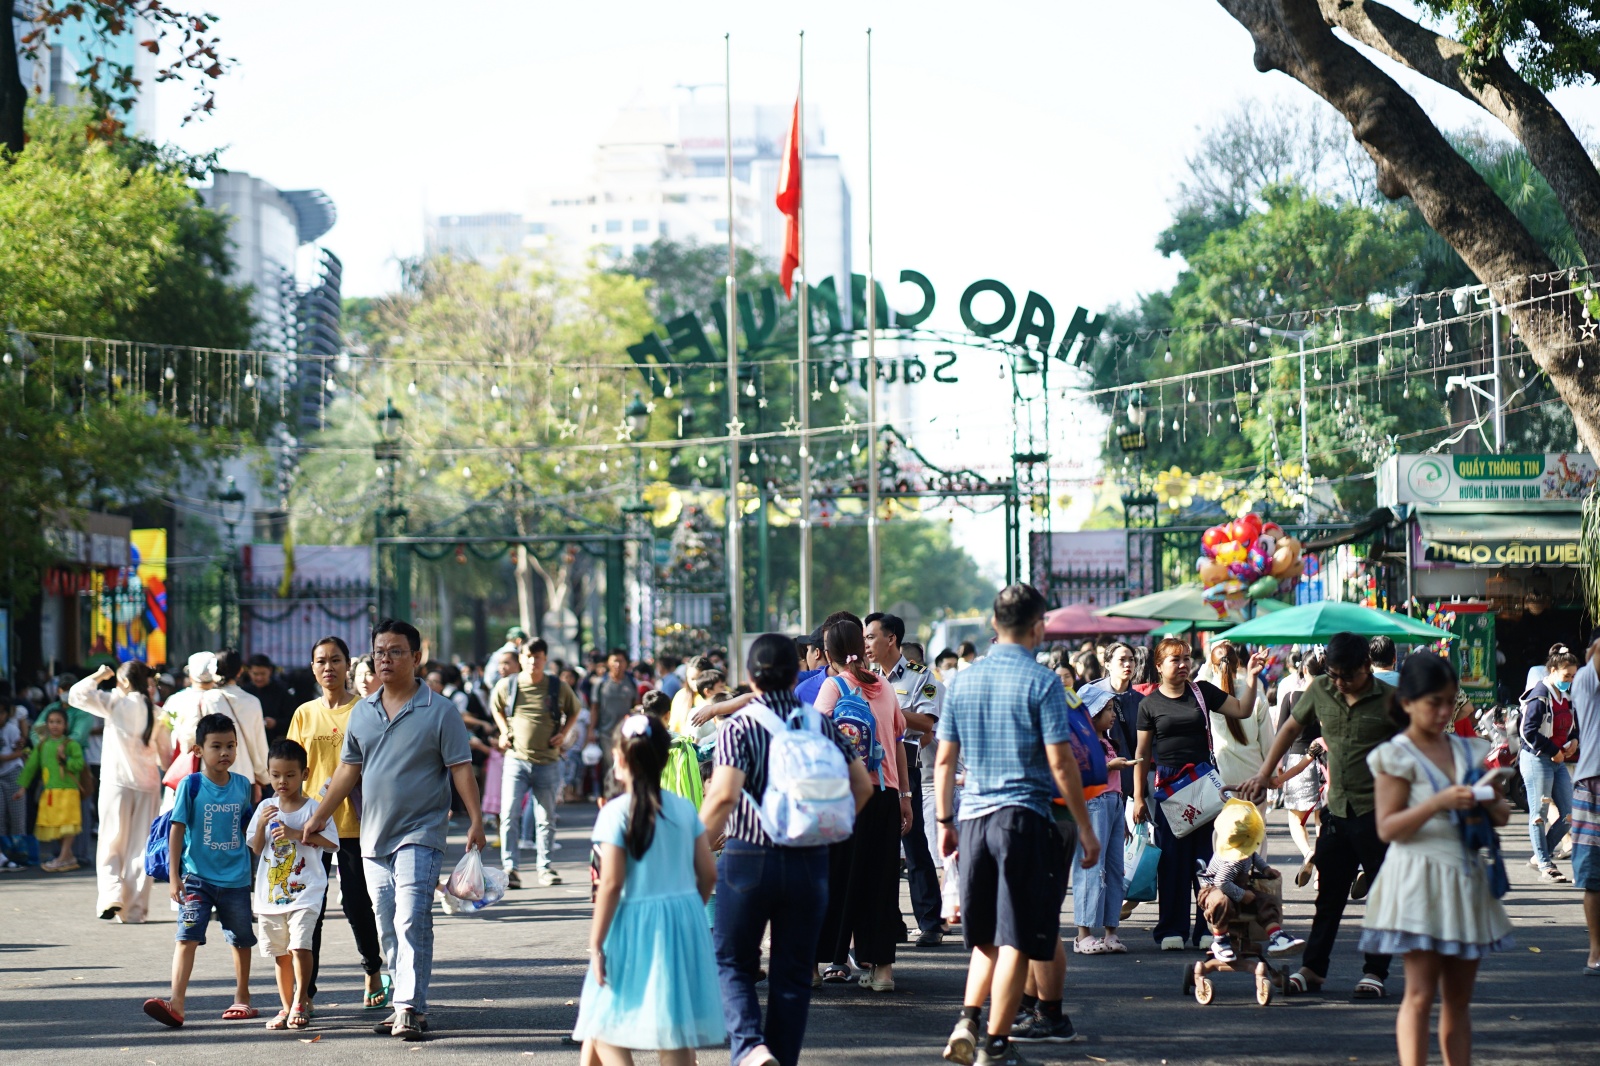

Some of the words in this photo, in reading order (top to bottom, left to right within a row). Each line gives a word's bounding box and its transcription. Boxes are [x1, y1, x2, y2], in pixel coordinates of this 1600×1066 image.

[1488, 458, 1520, 476] THÔNG
[1523, 461, 1540, 476] TIN
[1501, 485, 1520, 499] THAM
[1522, 485, 1541, 501] QUAN
[203, 811, 213, 846] KINETIC
